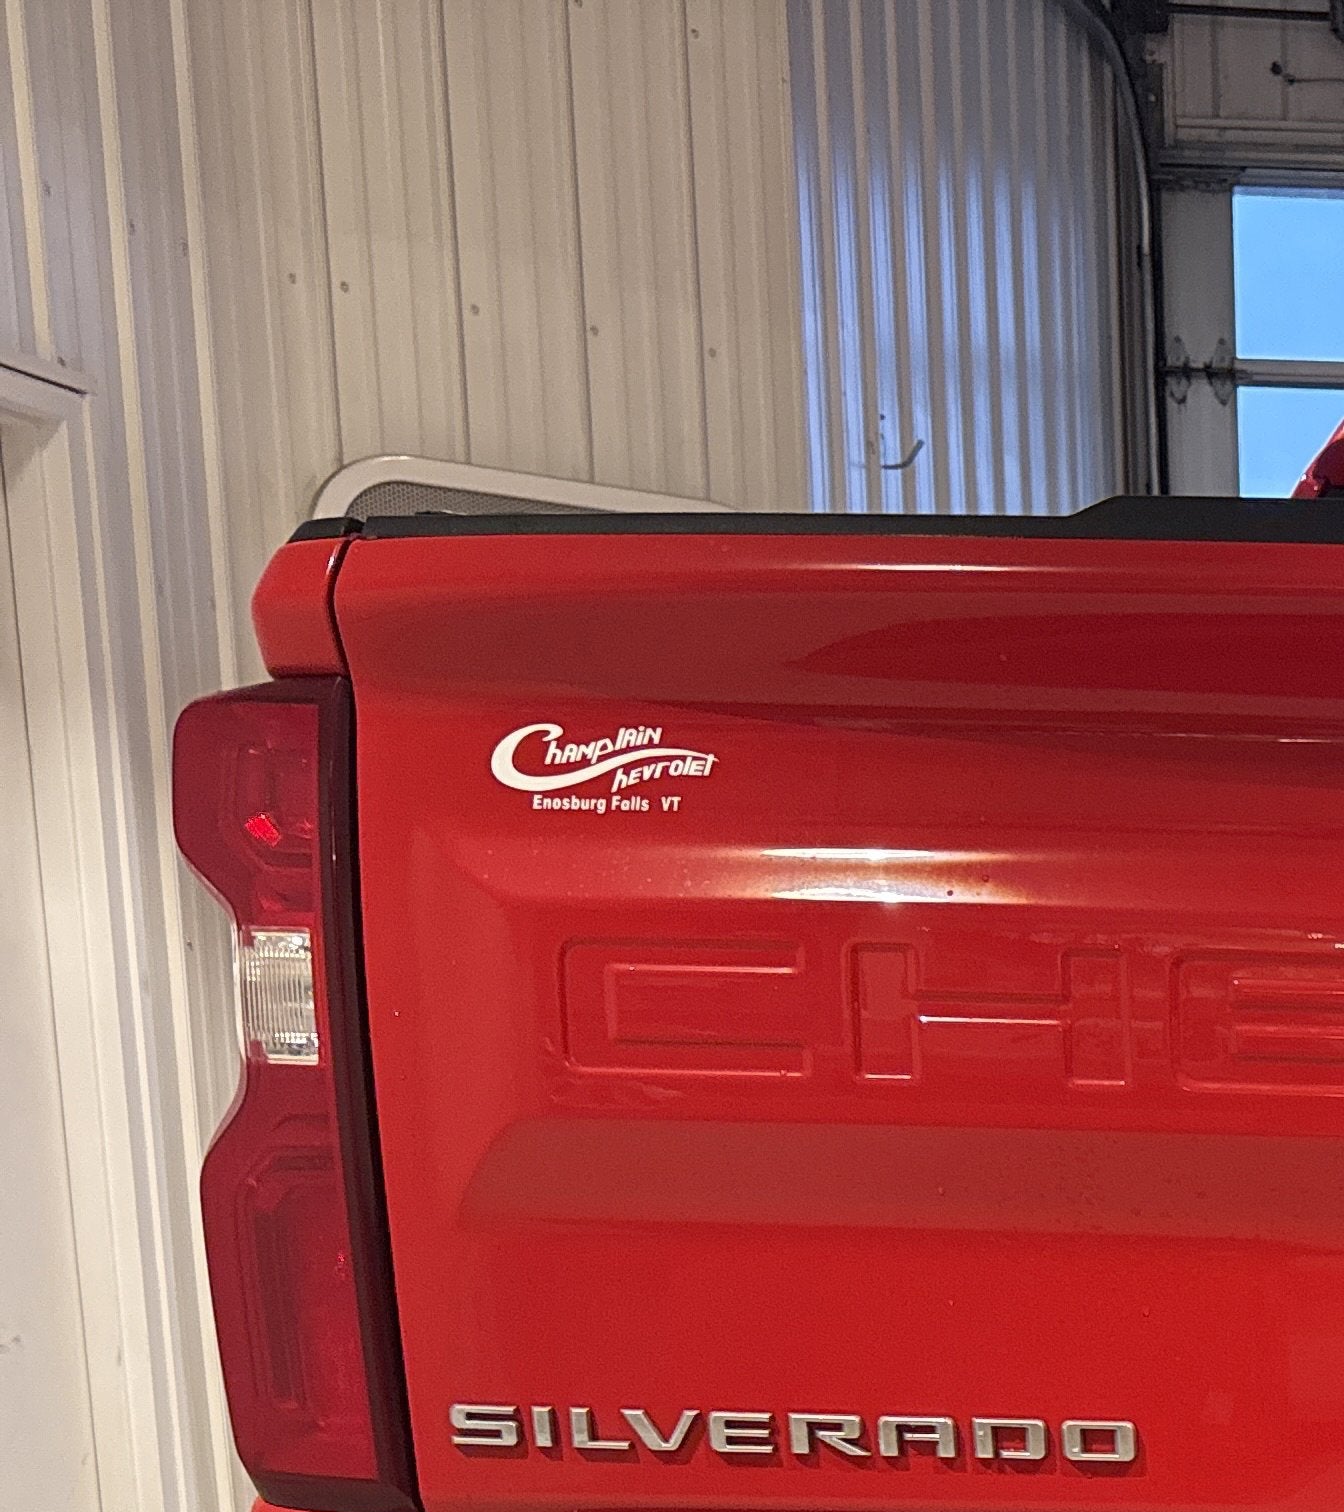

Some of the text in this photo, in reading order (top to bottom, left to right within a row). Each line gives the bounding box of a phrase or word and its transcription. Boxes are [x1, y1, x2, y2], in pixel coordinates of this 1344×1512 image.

[532, 794, 681, 814] Enosburg Falls VT
[448, 1403, 1138, 1463] SILVERADO
